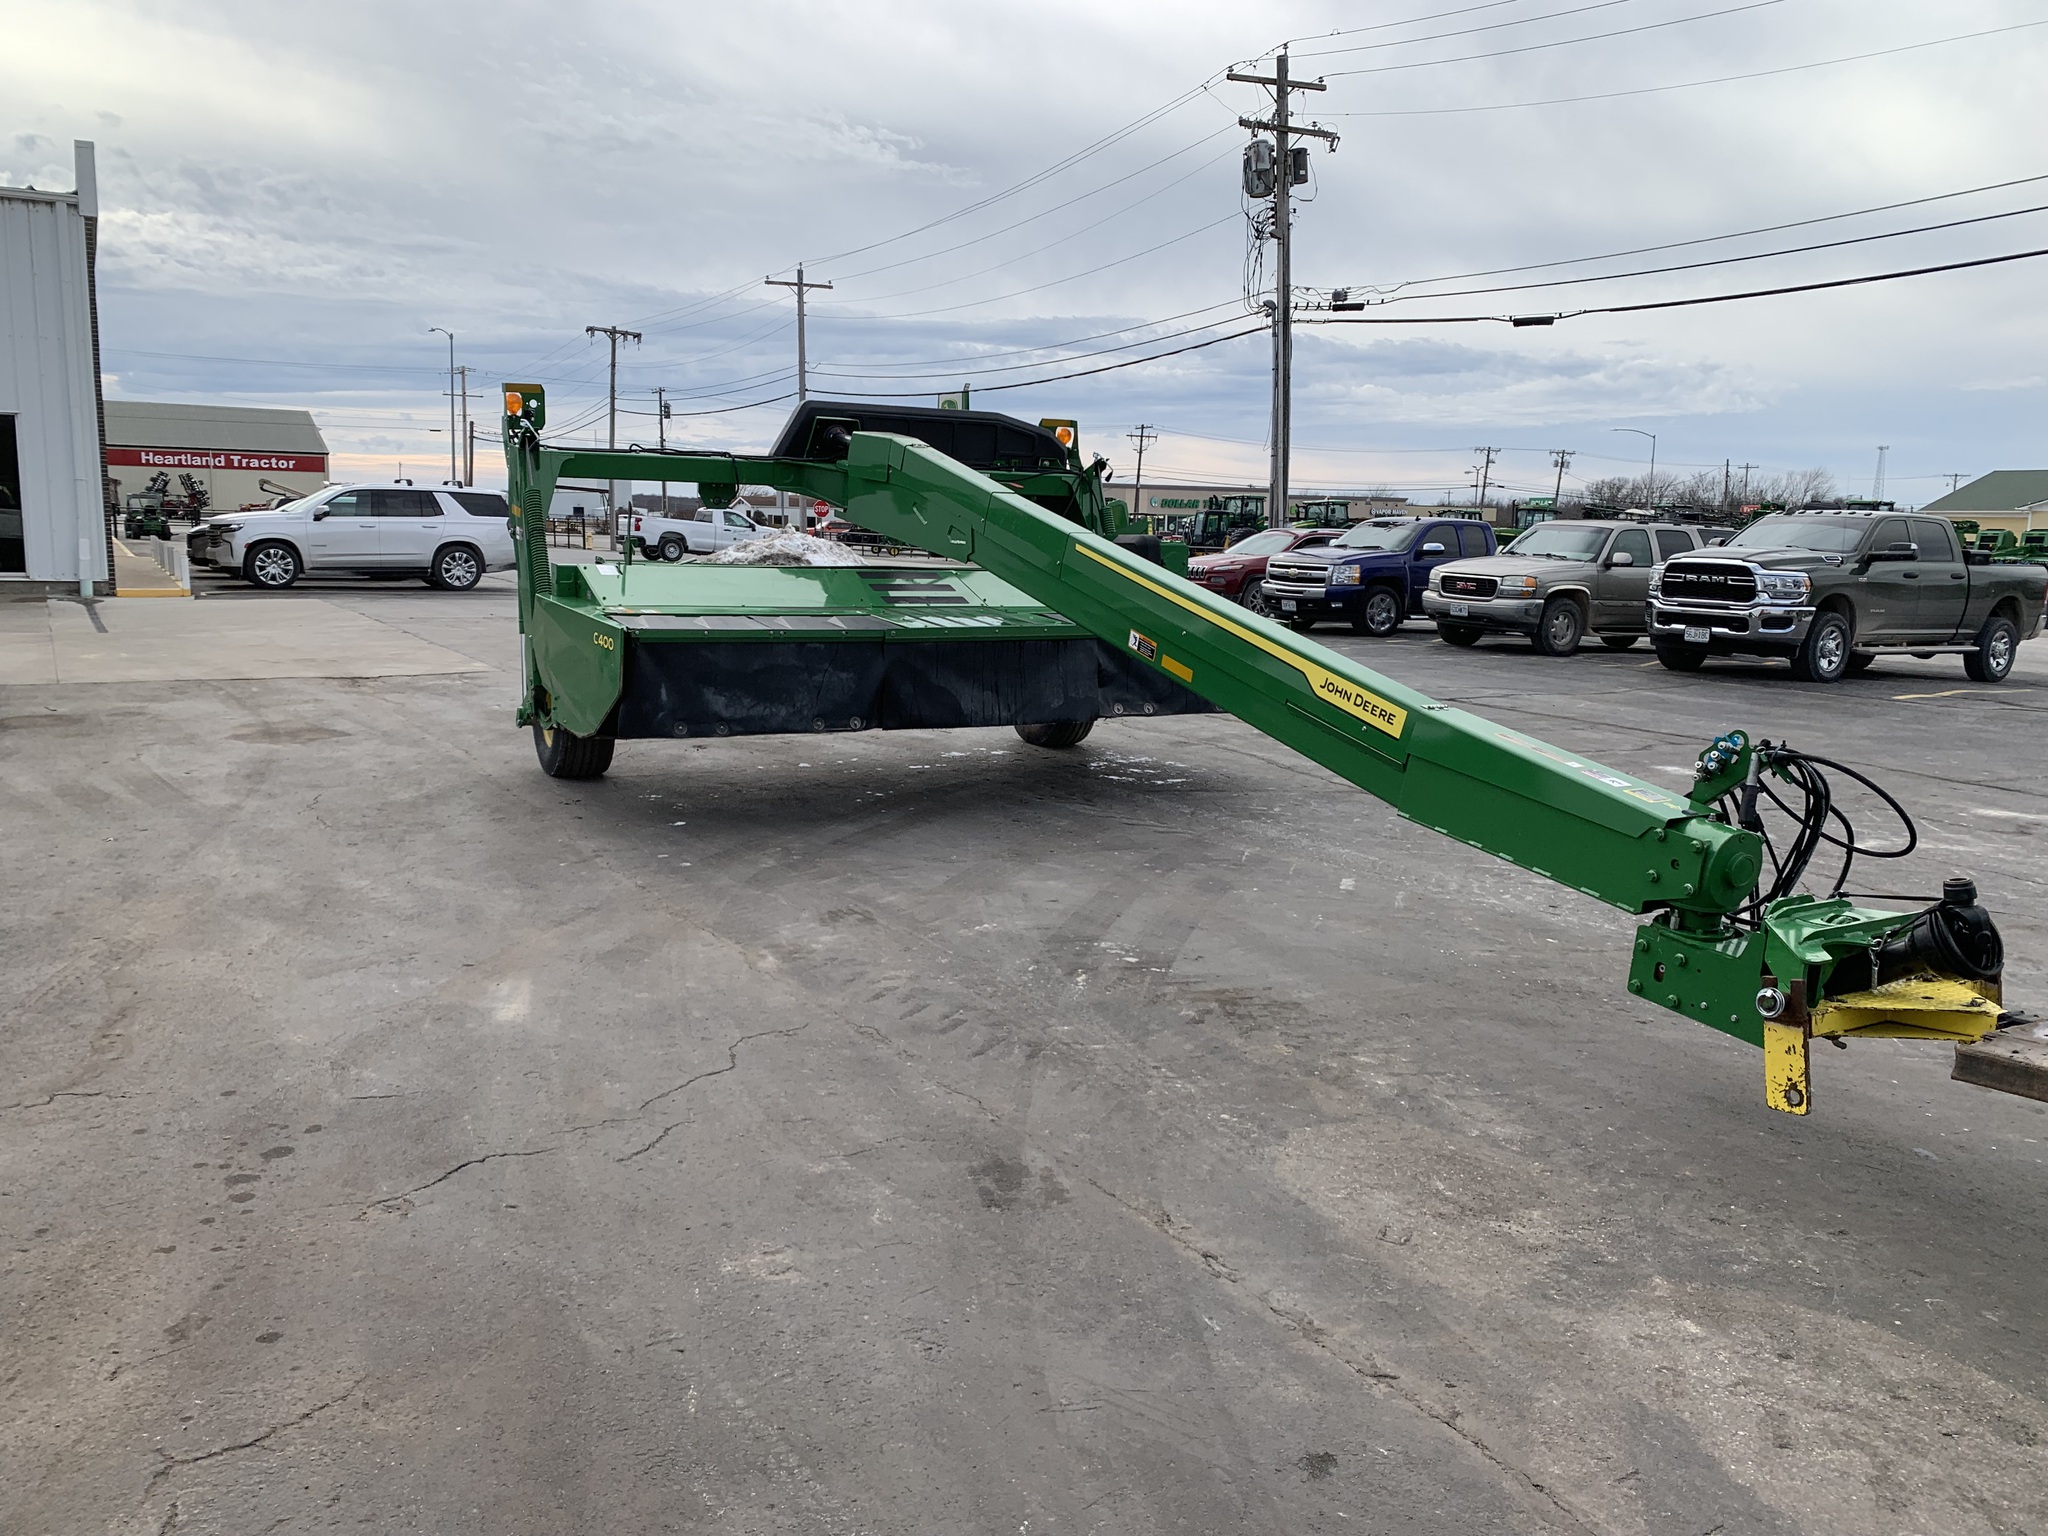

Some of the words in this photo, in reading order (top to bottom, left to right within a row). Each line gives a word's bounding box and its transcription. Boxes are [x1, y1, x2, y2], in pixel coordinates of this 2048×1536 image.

[140, 451, 225, 467] Heartland
[230, 455, 296, 469] Tractor
[1161, 498, 1200, 509] DOLLAR
[814, 505, 829, 513] STOP
[1392, 508, 1408, 516] MAVEN
[1685, 574, 1725, 583] RAM
[1456, 581, 1477, 590] GMC
[593, 631, 614, 651] C400
[1319, 677, 1353, 703] JOHN
[1353, 693, 1396, 726] DEERE
